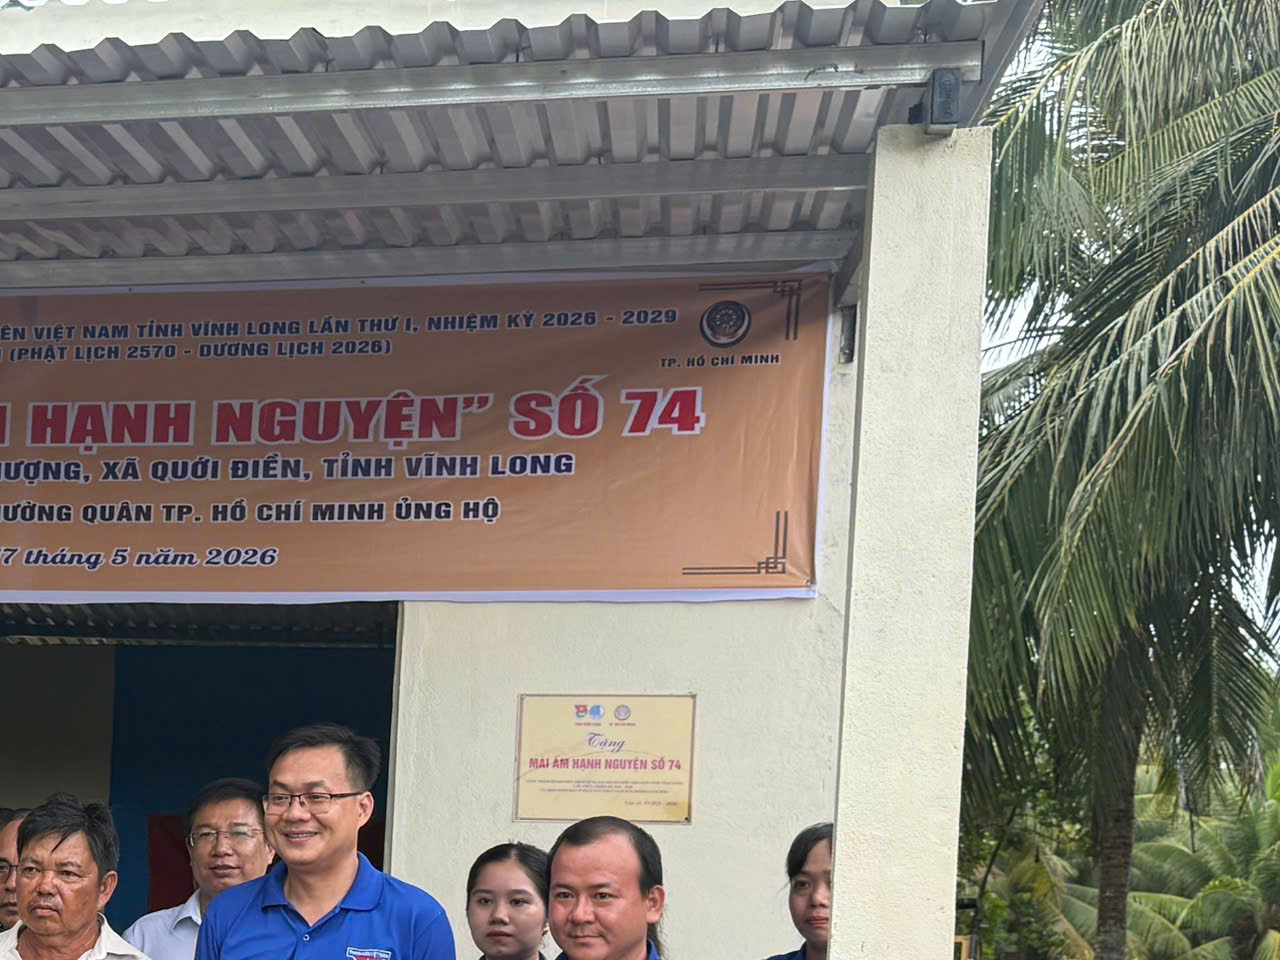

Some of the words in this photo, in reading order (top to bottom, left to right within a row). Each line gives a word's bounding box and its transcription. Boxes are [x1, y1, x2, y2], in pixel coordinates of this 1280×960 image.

[33, 324, 75, 343] VIỆT
[82, 324, 129, 340] NAM
[190, 322, 240, 338] VĨNH
[246, 320, 301, 336] LONG
[357, 315, 399, 333] THỨ
[404, 316, 418, 333] I,
[426, 312, 498, 332] NHIỆM
[506, 310, 535, 328] KỲ
[542, 312, 597, 328] 2026
[621, 309, 679, 326] 2029
[9, 345, 69, 363] (PHẬT
[74, 344, 120, 362] LỊCH
[126, 344, 178, 359] 2570
[198, 341, 269, 358] DƯƠNG
[276, 340, 324, 358] LỊCH
[330, 339, 391, 356] 2026)
[661, 358, 681, 368] TP.
[711, 355, 734, 366] CHÍ
[740, 354, 779, 364] MINH
[28, 402, 193, 452] HẠNH
[510, 377, 602, 438] SỐ
[622, 387, 703, 436] 74
[101, 458, 139, 481] XÃ
[151, 458, 219, 482] QUỚI
[230, 453, 311, 480] ĐIỀN,
[322, 453, 393, 479] TỈNH
[405, 453, 480, 477] VĨNH
[490, 454, 574, 476] LONG
[82, 502, 153, 524] QUÂN
[161, 504, 202, 522] TP.
[212, 500, 247, 521] HỒ
[257, 501, 302, 521] CHÍ
[312, 503, 386, 521] MINH
[395, 497, 452, 521] ỦNG
[462, 498, 500, 523] HỘ
[24, 548, 104, 571] tháng
[111, 549, 130, 564] 5
[135, 549, 198, 564] năm
[204, 548, 279, 565] 2026
[668, 760, 681, 770] 74
